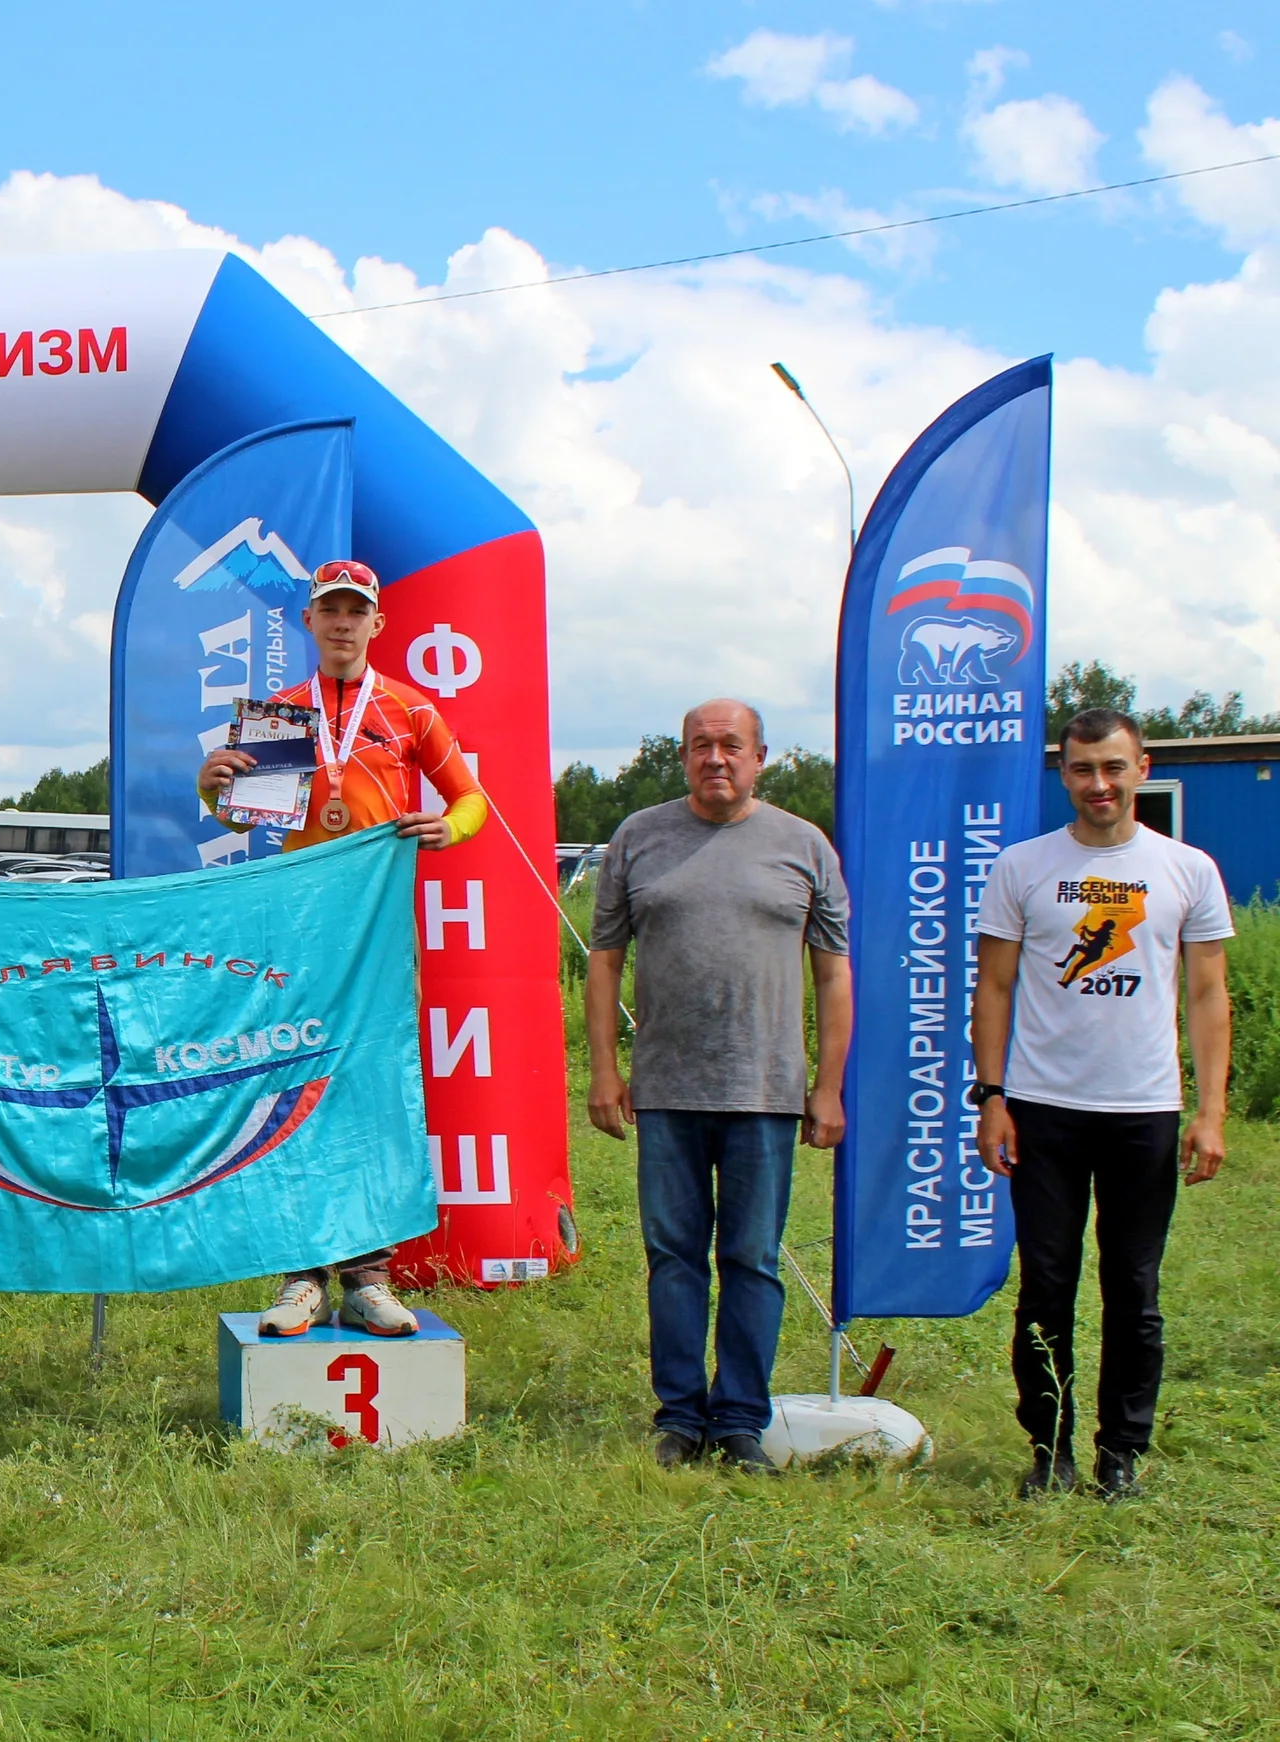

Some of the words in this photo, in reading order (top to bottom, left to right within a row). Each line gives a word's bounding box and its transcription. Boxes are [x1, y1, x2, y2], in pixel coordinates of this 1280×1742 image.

[266, 607, 284, 691] ОТДЫХА
[893, 691, 1022, 718] ЕДИНАЯ
[893, 719, 1022, 745] РОССИЯ
[1057, 892, 1129, 904] ПРИЗЫВ
[1058, 880, 1148, 894] ВЕСЕННИЙ
[1080, 974, 1142, 997] 2017
[155, 1018, 324, 1073] КОСМОС
[901, 840, 946, 1249] КРАСНОАРМЕЙСКОЕ
[327, 1353, 379, 1449] 3
